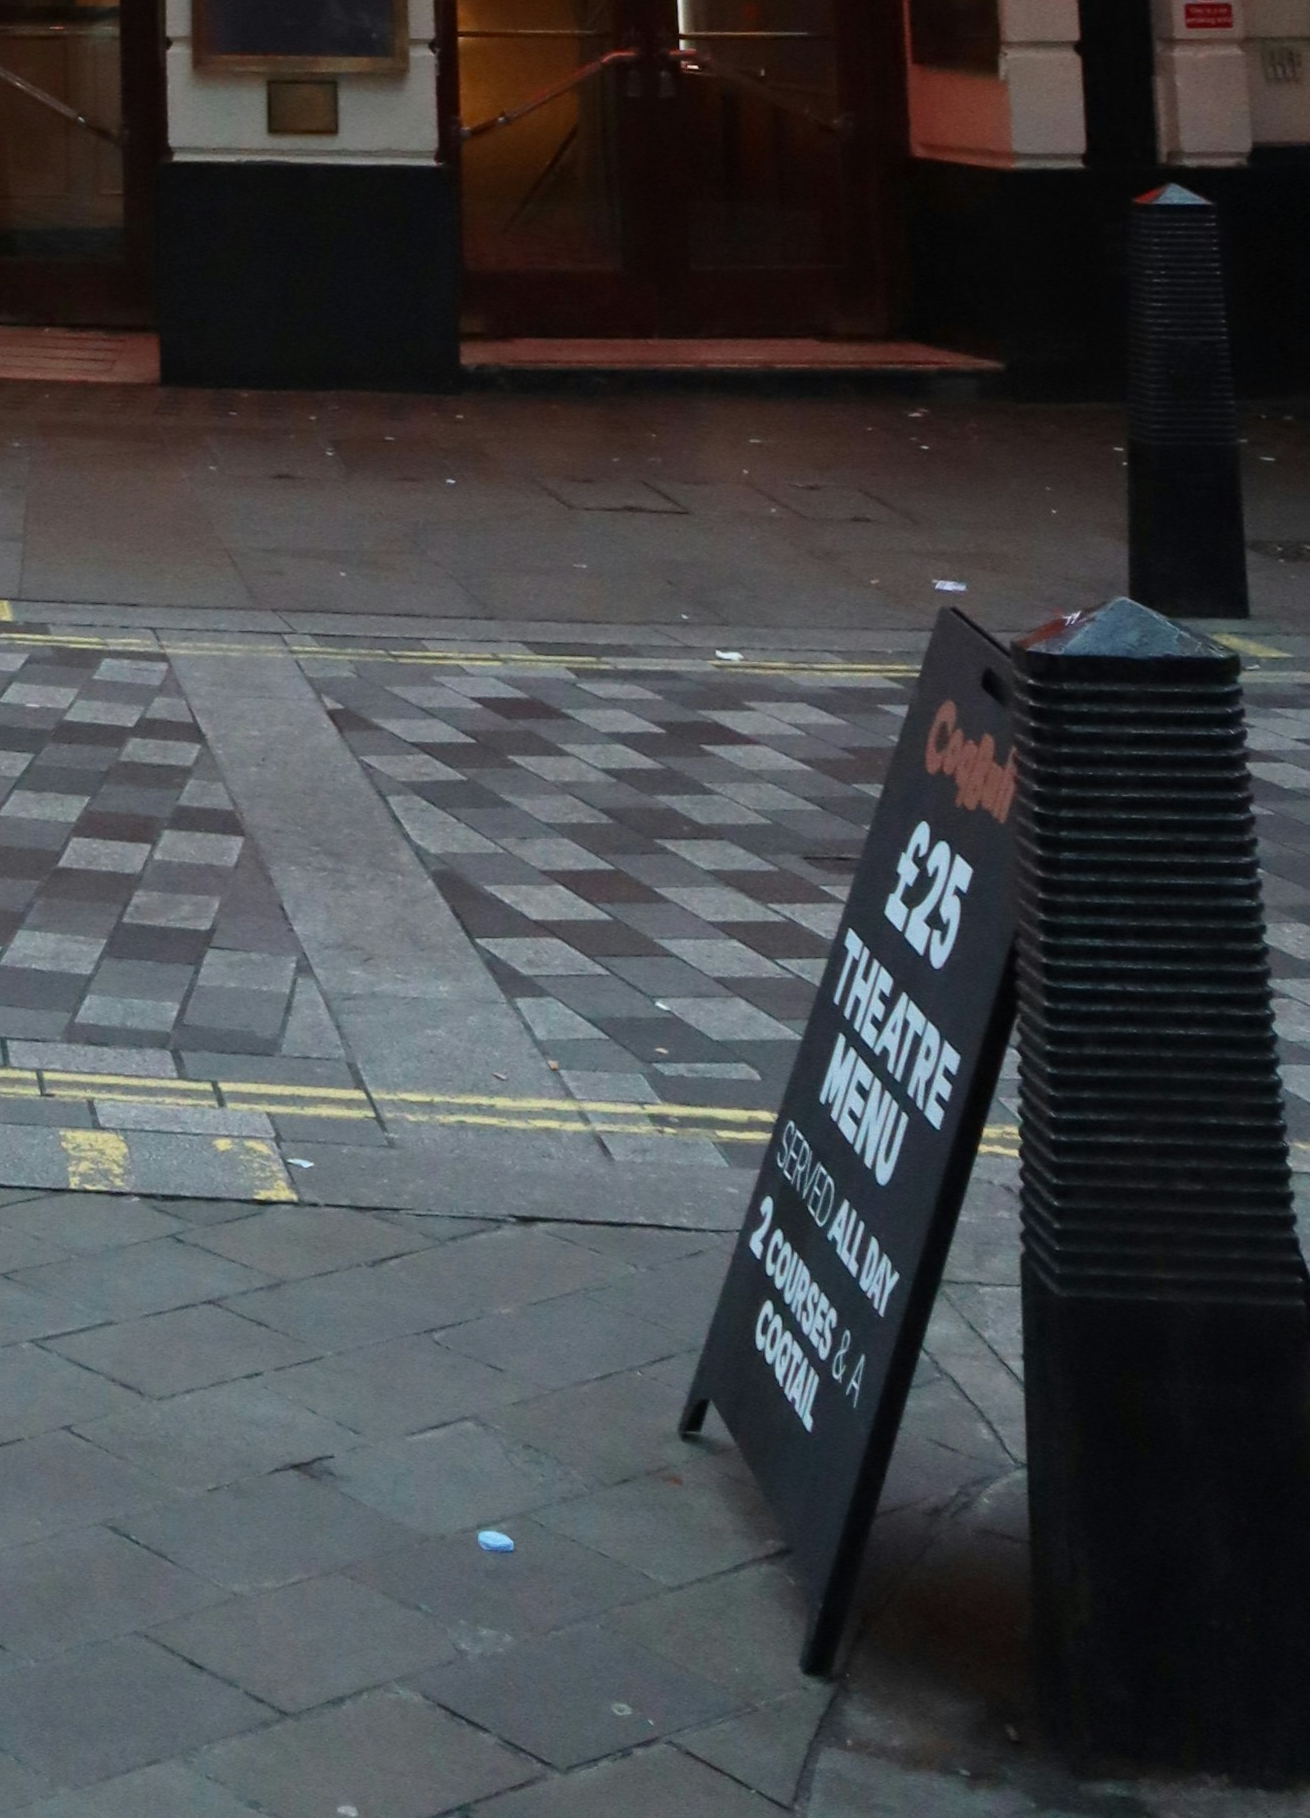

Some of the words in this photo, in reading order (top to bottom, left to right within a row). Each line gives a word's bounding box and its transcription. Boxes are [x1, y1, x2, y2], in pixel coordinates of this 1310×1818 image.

[883, 819, 974, 970] £25
[819, 1031, 909, 1187] MENU
[833, 926, 962, 1131] THEATRE
[748, 1195, 774, 1261] 2
[764, 1228, 838, 1362] COURSES
[832, 1329, 852, 1385] &
[846, 1352, 866, 1410] A
[776, 1119, 836, 1229] SERVED
[826, 1198, 861, 1280] ALL
[860, 1247, 900, 1318] DAY
[754, 1299, 821, 1433] COQTAIL
